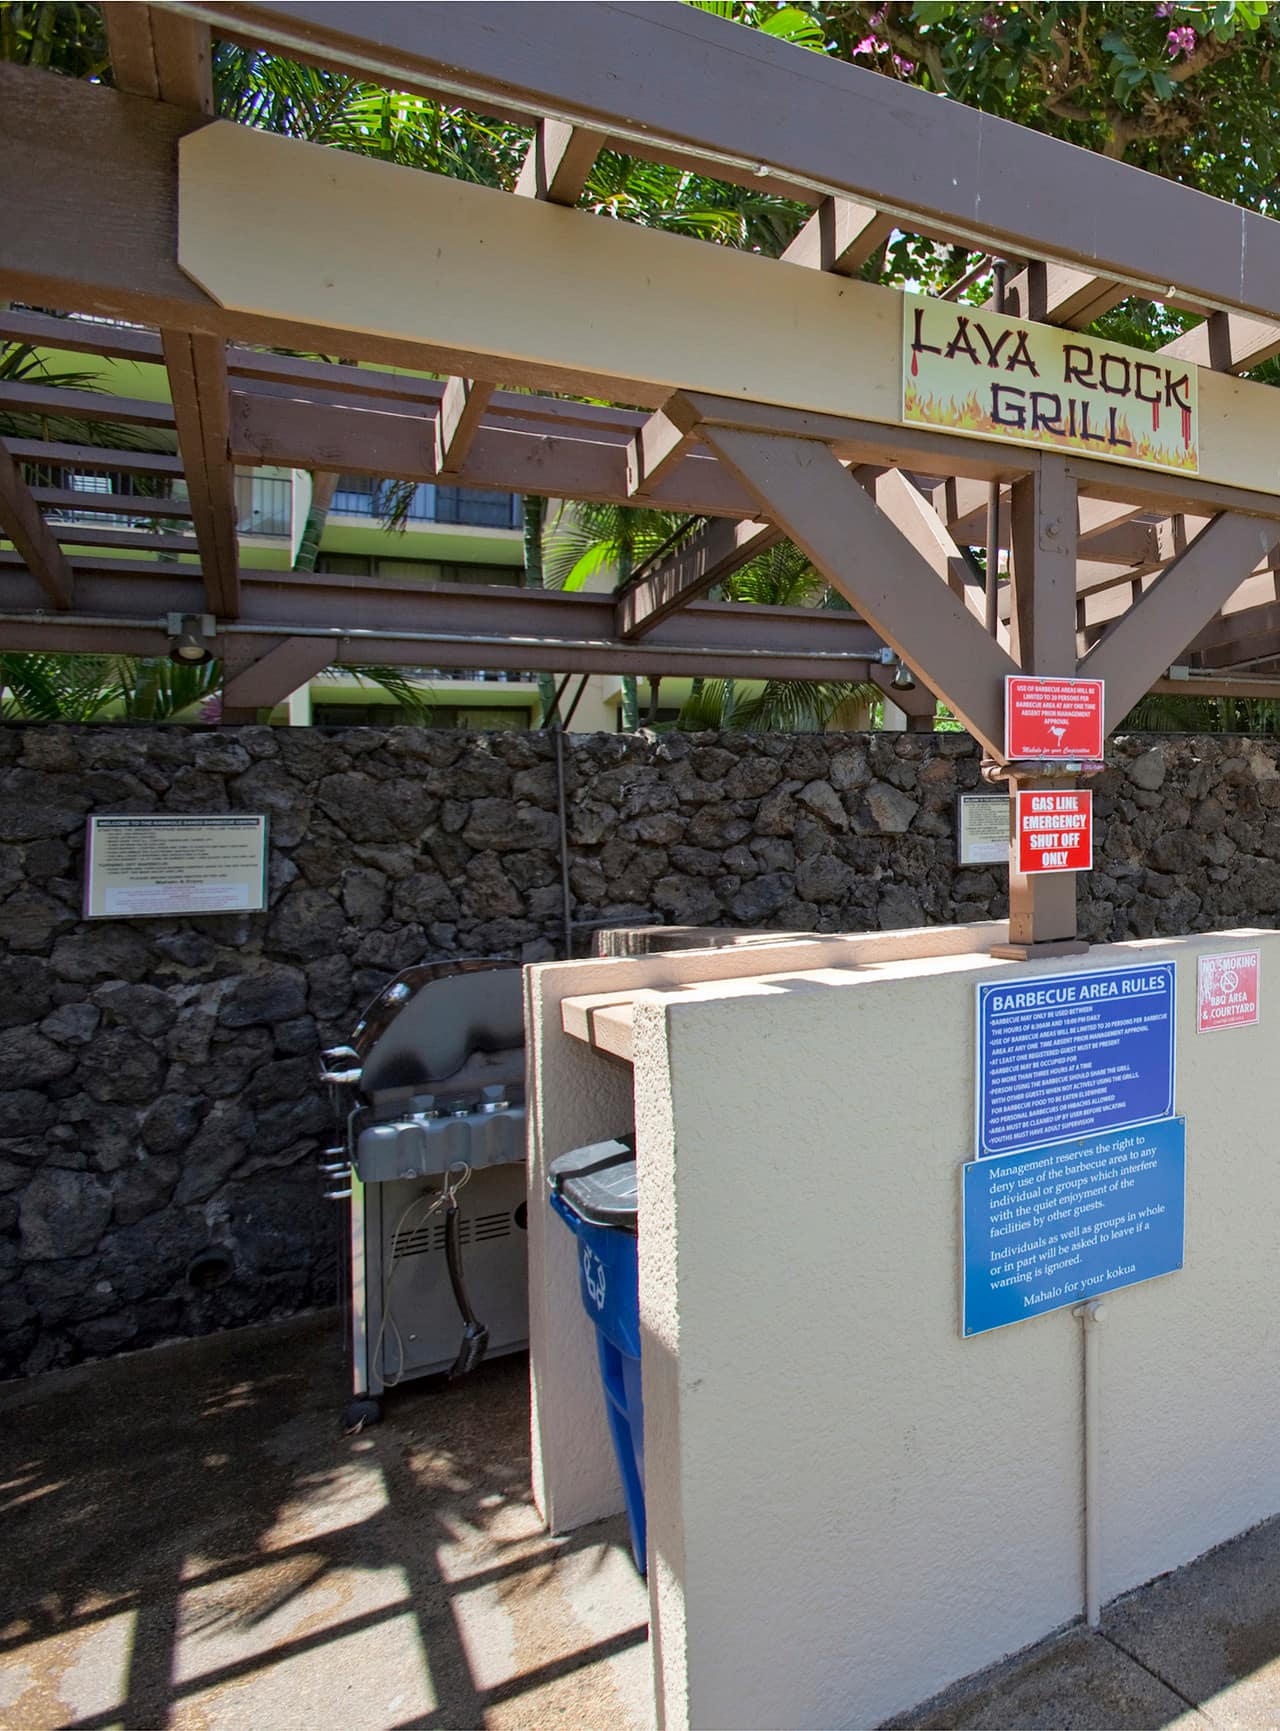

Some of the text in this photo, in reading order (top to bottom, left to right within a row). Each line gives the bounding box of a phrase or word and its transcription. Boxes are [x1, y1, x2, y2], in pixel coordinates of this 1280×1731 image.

[910, 308, 1192, 413] LAVA ROCK
[990, 382, 1132, 447] GRILL
[1023, 815, 1086, 829] EMERGENCY
[1032, 796, 1078, 811] GAS LINE
[1030, 833, 1080, 848] SHUT OFF
[1041, 852, 1068, 866] ONLY
[1219, 955, 1256, 970] SMOKING
[993, 975, 1164, 1010] BARBECUE AREA RULES
[1203, 1002, 1255, 1019] & COURTYARD
[1229, 992, 1248, 1003] AREA
[989, 1136, 1144, 1179] Management reserves the right to
[989, 1147, 1156, 1193] deny use of the barbecue area to any
[990, 1160, 1156, 1208] individual or groups which interfere
[990, 1178, 1134, 1222] with the quiet enjoyment of the
[990, 1200, 1104, 1237] facilities by other guests.
[991, 1204, 1164, 1260] Individuals as well as groups in whole
[990, 1266, 1001, 1275] or
[1004, 1262, 1013, 1271] in
[1016, 1255, 1035, 1270] part
[1039, 1247, 1055, 1260] will
[1058, 1245, 1069, 1254] be
[1071, 1234, 1096, 1250] asked
[1100, 1234, 1108, 1242] to
[1111, 1227, 1133, 1239] leave
[1136, 1222, 1142, 1231] if
[990, 1254, 1081, 1288] warning is ignored.
[1024, 1265, 1135, 1306] Mahalo for your kokua
